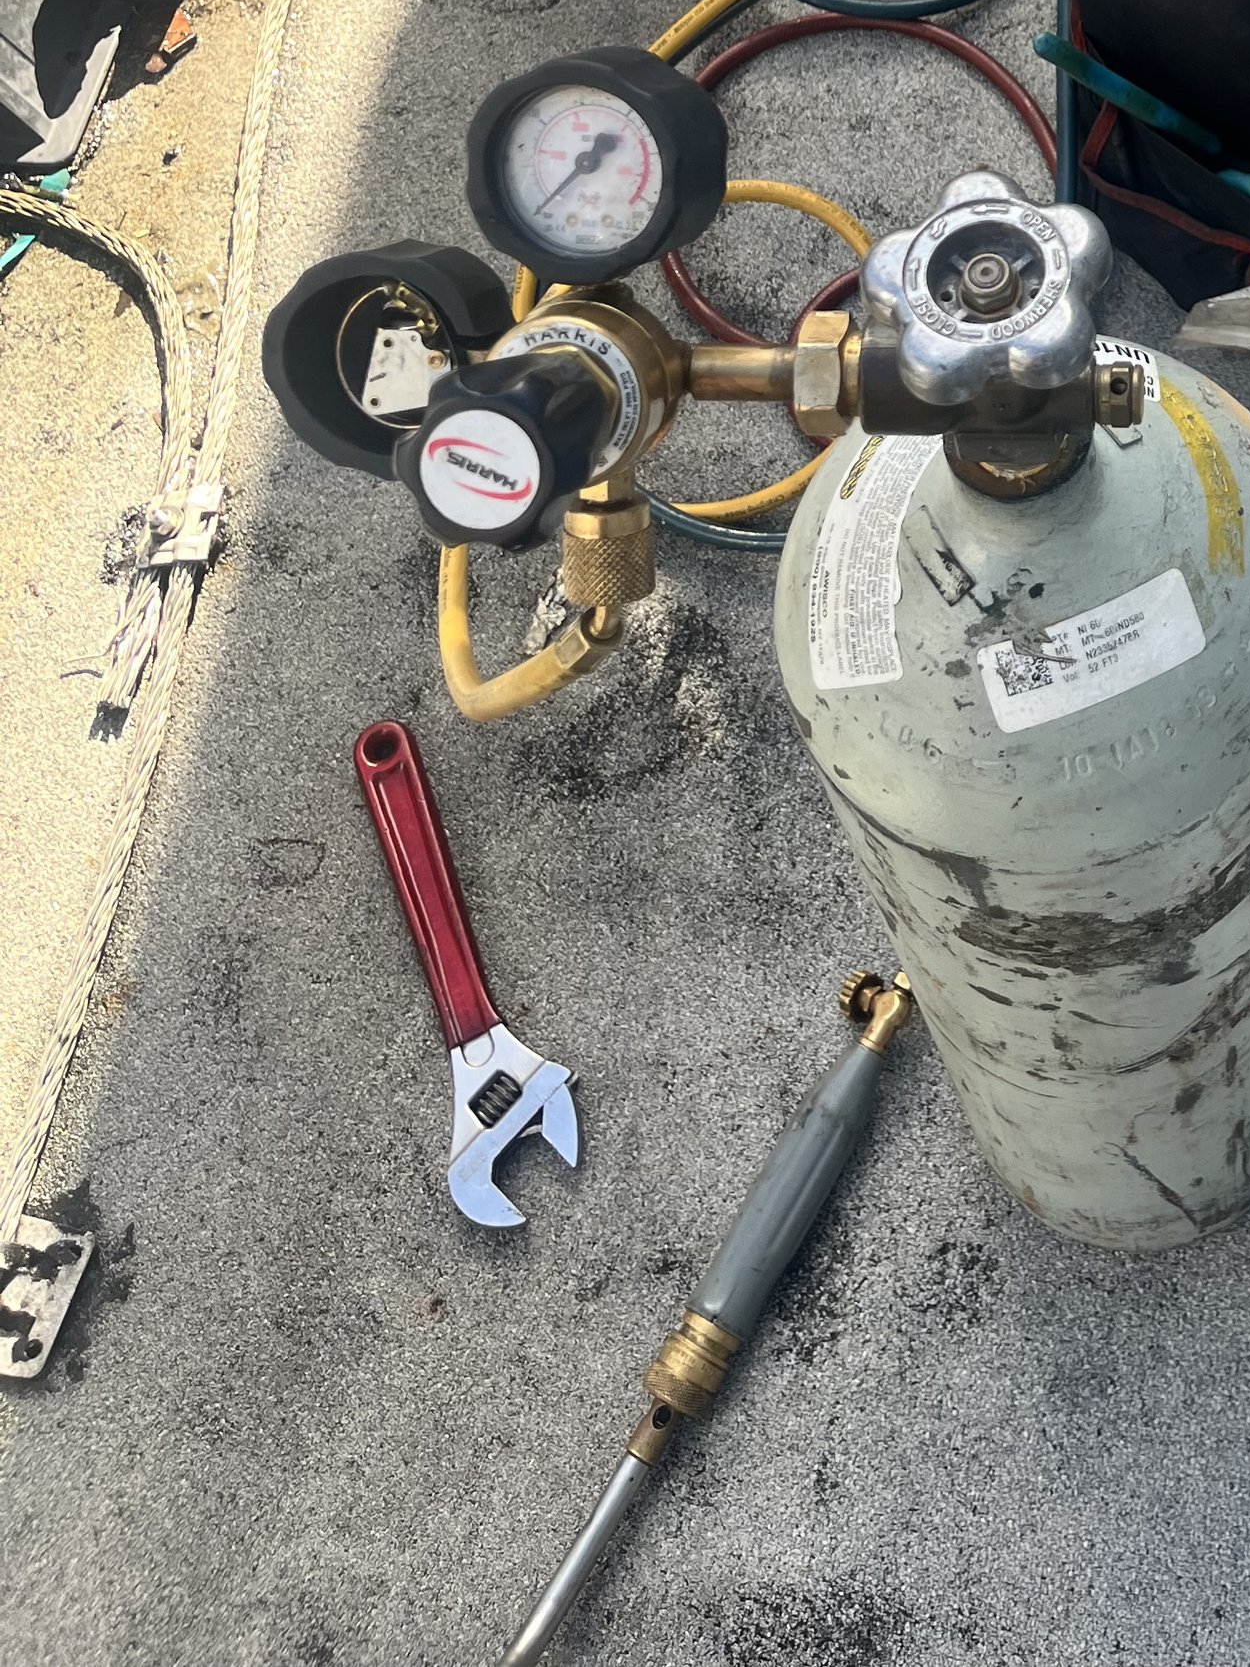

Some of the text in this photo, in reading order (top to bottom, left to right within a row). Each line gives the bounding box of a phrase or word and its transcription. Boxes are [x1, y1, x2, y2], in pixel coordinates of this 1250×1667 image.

[1021, 209, 1056, 242] OPEN
[912, 294, 956, 335] CLOSE
[991, 278, 1062, 339] SHERWOOD
[524, 327, 612, 355] HARRIS
[445, 451, 519, 492] HARRIS
[822, 570, 830, 618] AWISCO
[1087, 661, 1100, 674] 52
